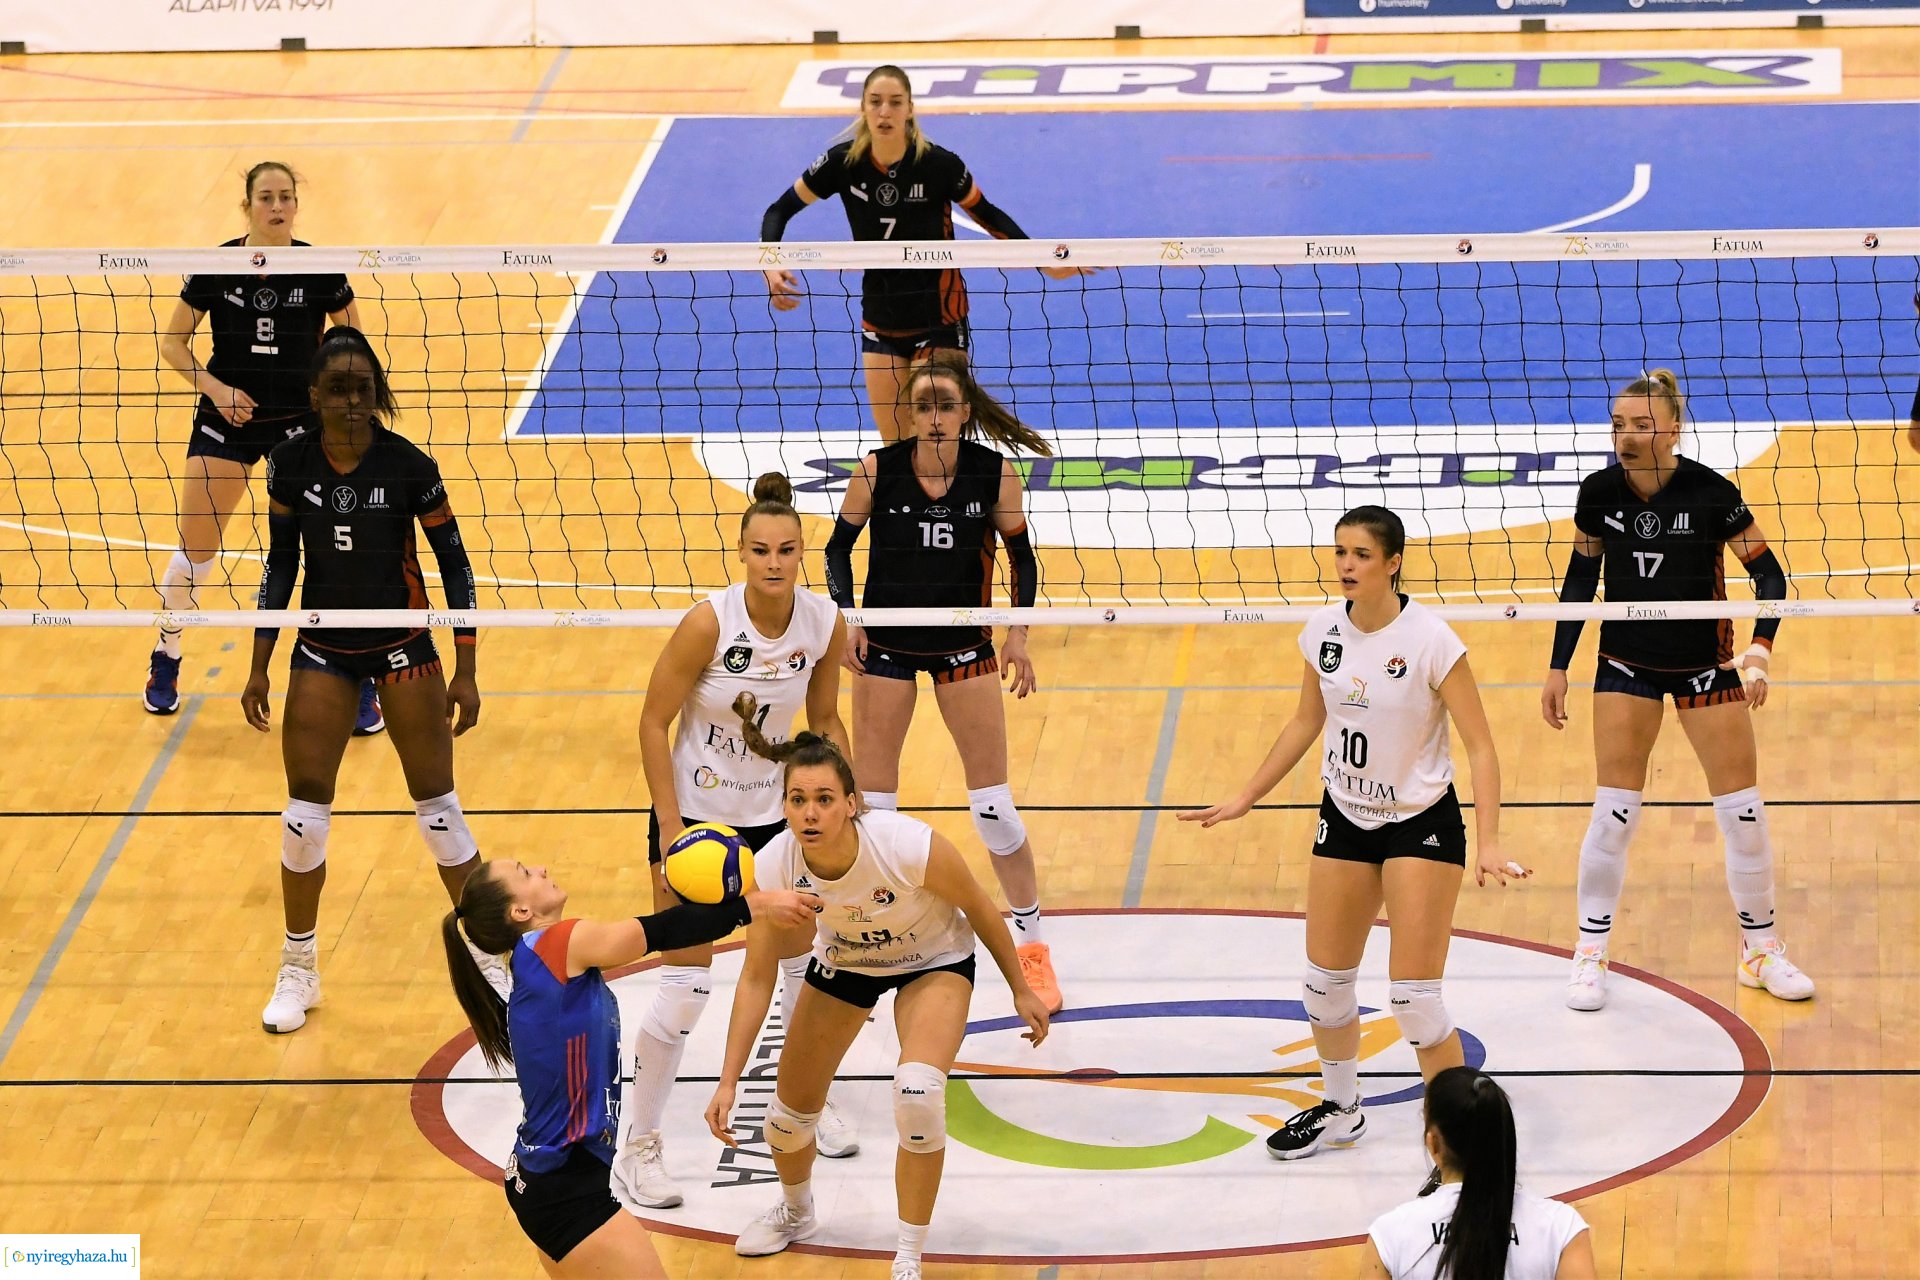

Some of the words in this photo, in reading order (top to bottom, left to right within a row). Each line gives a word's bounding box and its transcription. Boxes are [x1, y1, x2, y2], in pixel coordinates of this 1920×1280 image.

[880, 217, 897, 240] 7
[1305, 242, 1356, 256] FATUM
[1712, 237, 1763, 251] FATUM
[98, 253, 149, 268] FATUM
[502, 250, 552, 265] FATUM
[903, 246, 953, 261] FATUM
[257, 318, 274, 341] 8
[334, 525, 353, 551] 5
[918, 522, 955, 549] 16
[1633, 552, 1664, 578] 17
[33, 613, 72, 625] FATUM
[427, 613, 466, 625] FATUM
[1224, 609, 1264, 622] FATUM
[1627, 606, 1667, 618] FATUM
[388, 648, 409, 669] 5
[1688, 668, 1716, 693] 17
[1340, 727, 1368, 769] 10
[1423, 839, 1441, 847] adidas
